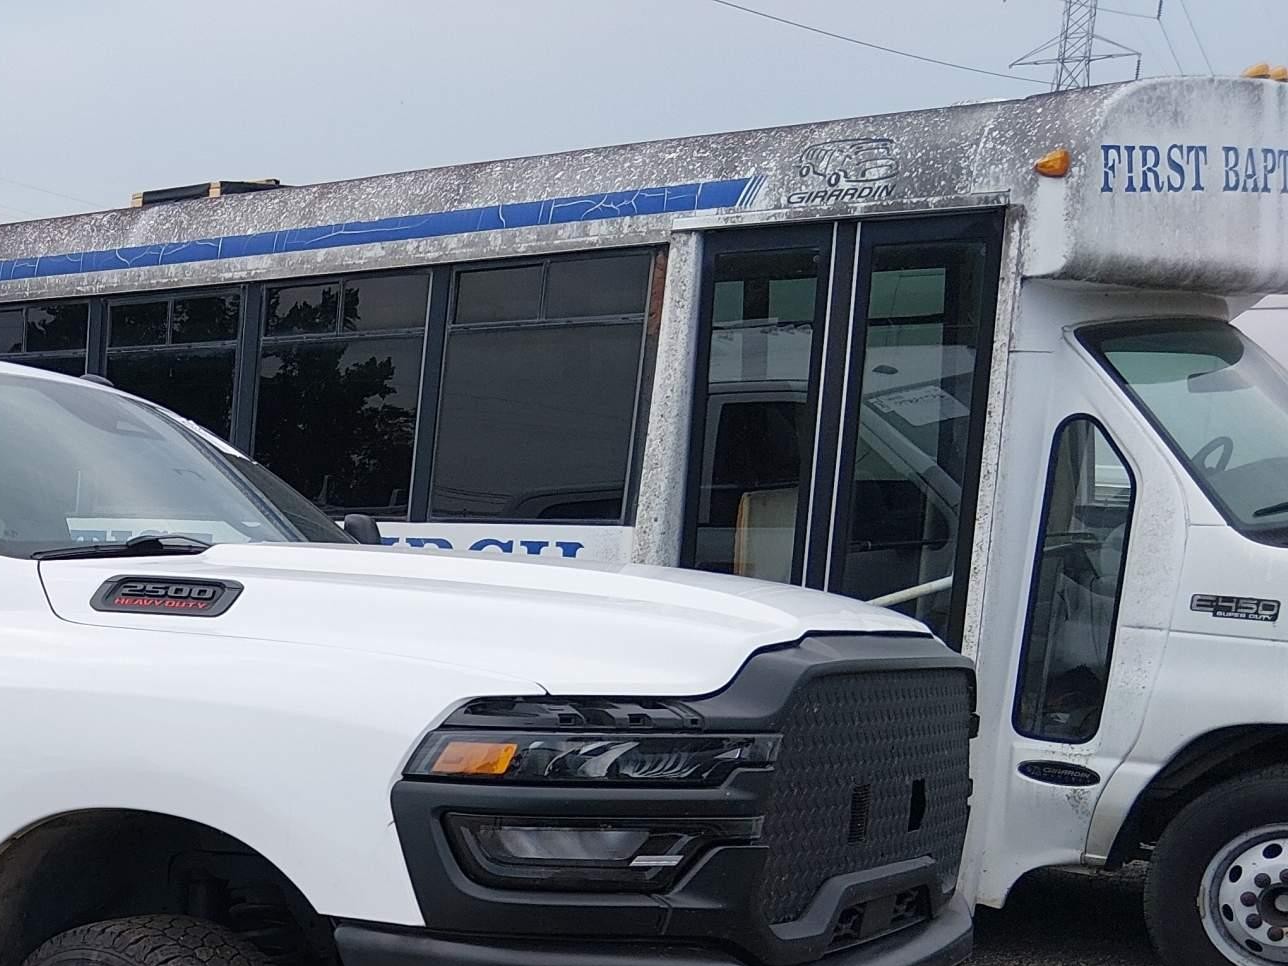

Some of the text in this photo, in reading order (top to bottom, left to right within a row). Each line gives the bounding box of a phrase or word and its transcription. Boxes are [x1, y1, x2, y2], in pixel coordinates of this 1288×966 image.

[1100, 143, 1208, 193] FIRST
[787, 184, 896, 205] GIRARDIN
[120, 582, 215, 600] 2500
[114, 597, 208, 610] HEAVY DUTY
